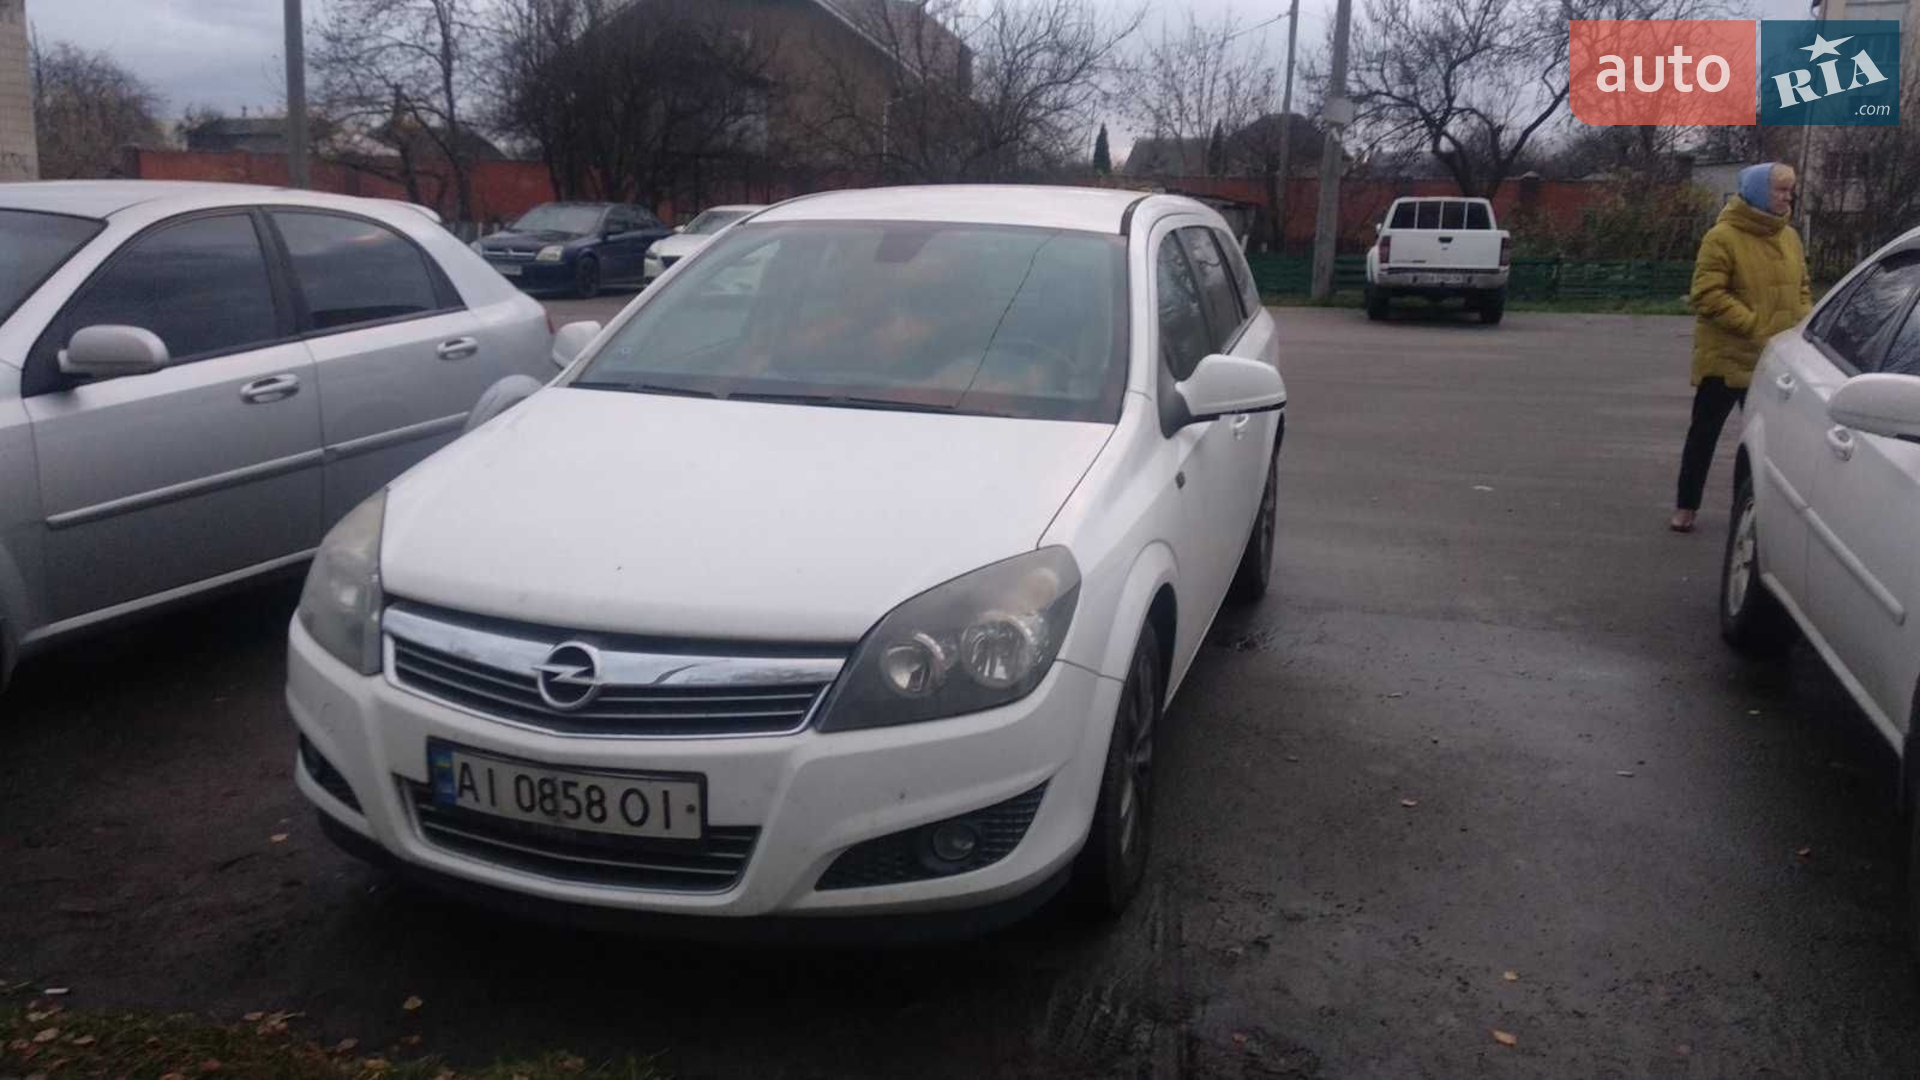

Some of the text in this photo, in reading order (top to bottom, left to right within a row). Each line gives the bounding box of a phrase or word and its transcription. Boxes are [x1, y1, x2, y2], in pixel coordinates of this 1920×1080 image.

[457, 761, 671, 830] AI 0858 OI
